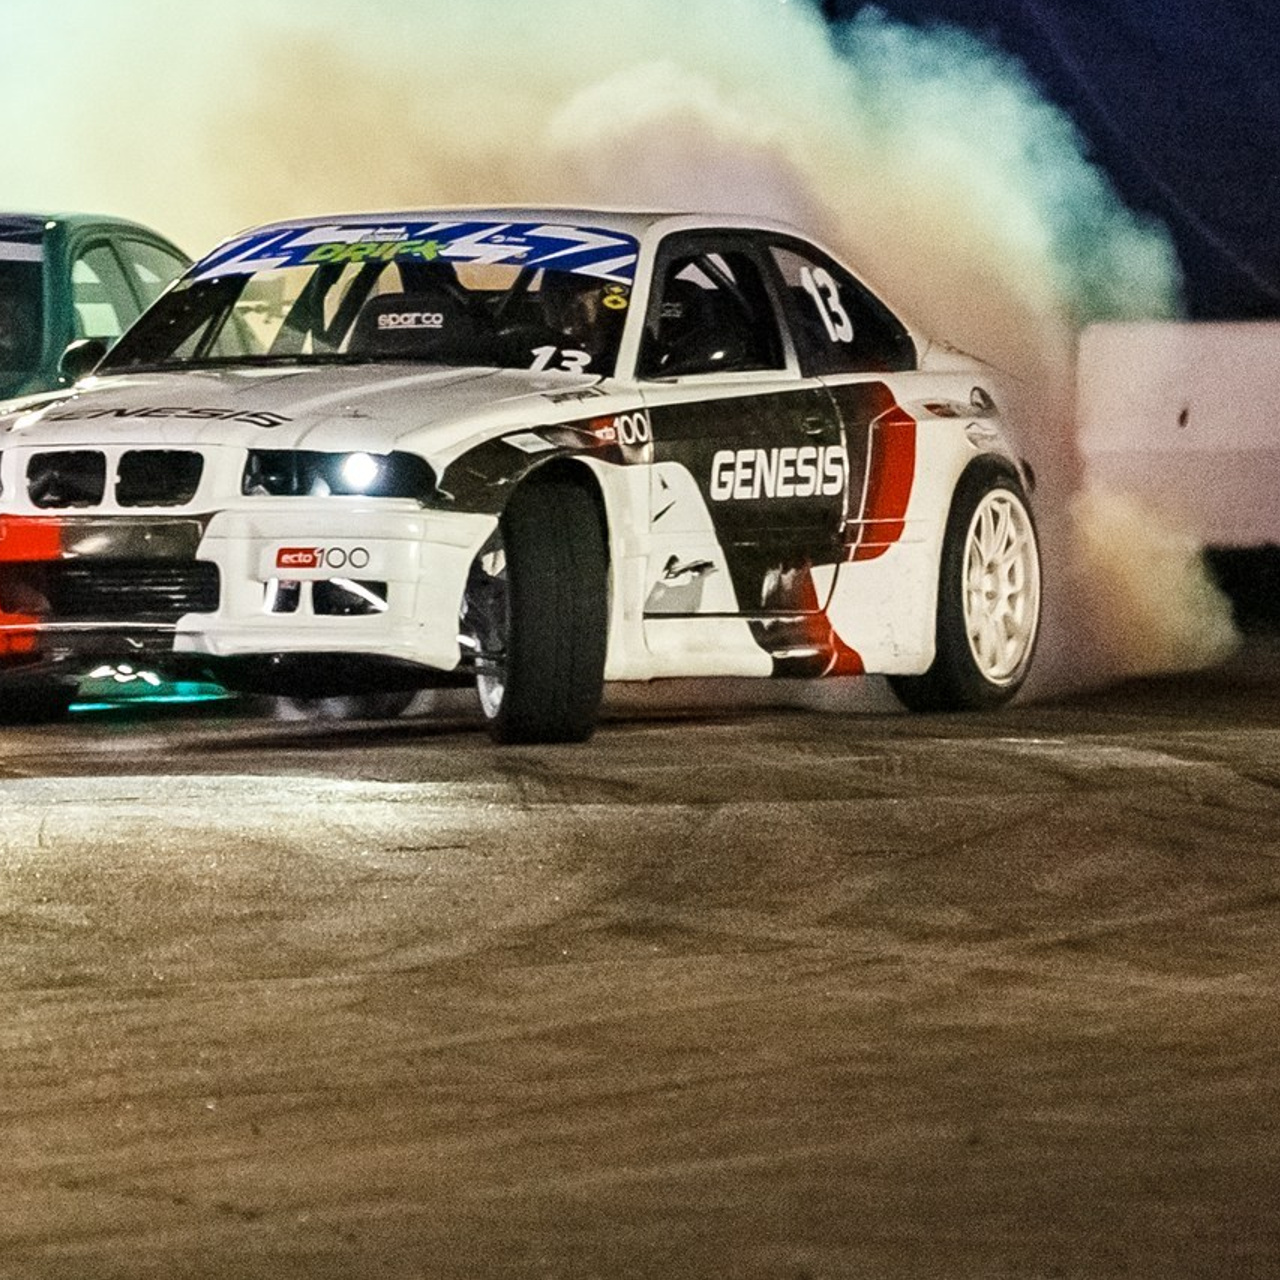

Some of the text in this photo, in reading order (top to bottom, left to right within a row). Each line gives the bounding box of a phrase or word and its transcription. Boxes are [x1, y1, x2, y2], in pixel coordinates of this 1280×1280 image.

[378, 312, 443, 329] sparco
[800, 266, 854, 343] 13
[531, 345, 592, 374] 13
[709, 445, 846, 502] GENESIS
